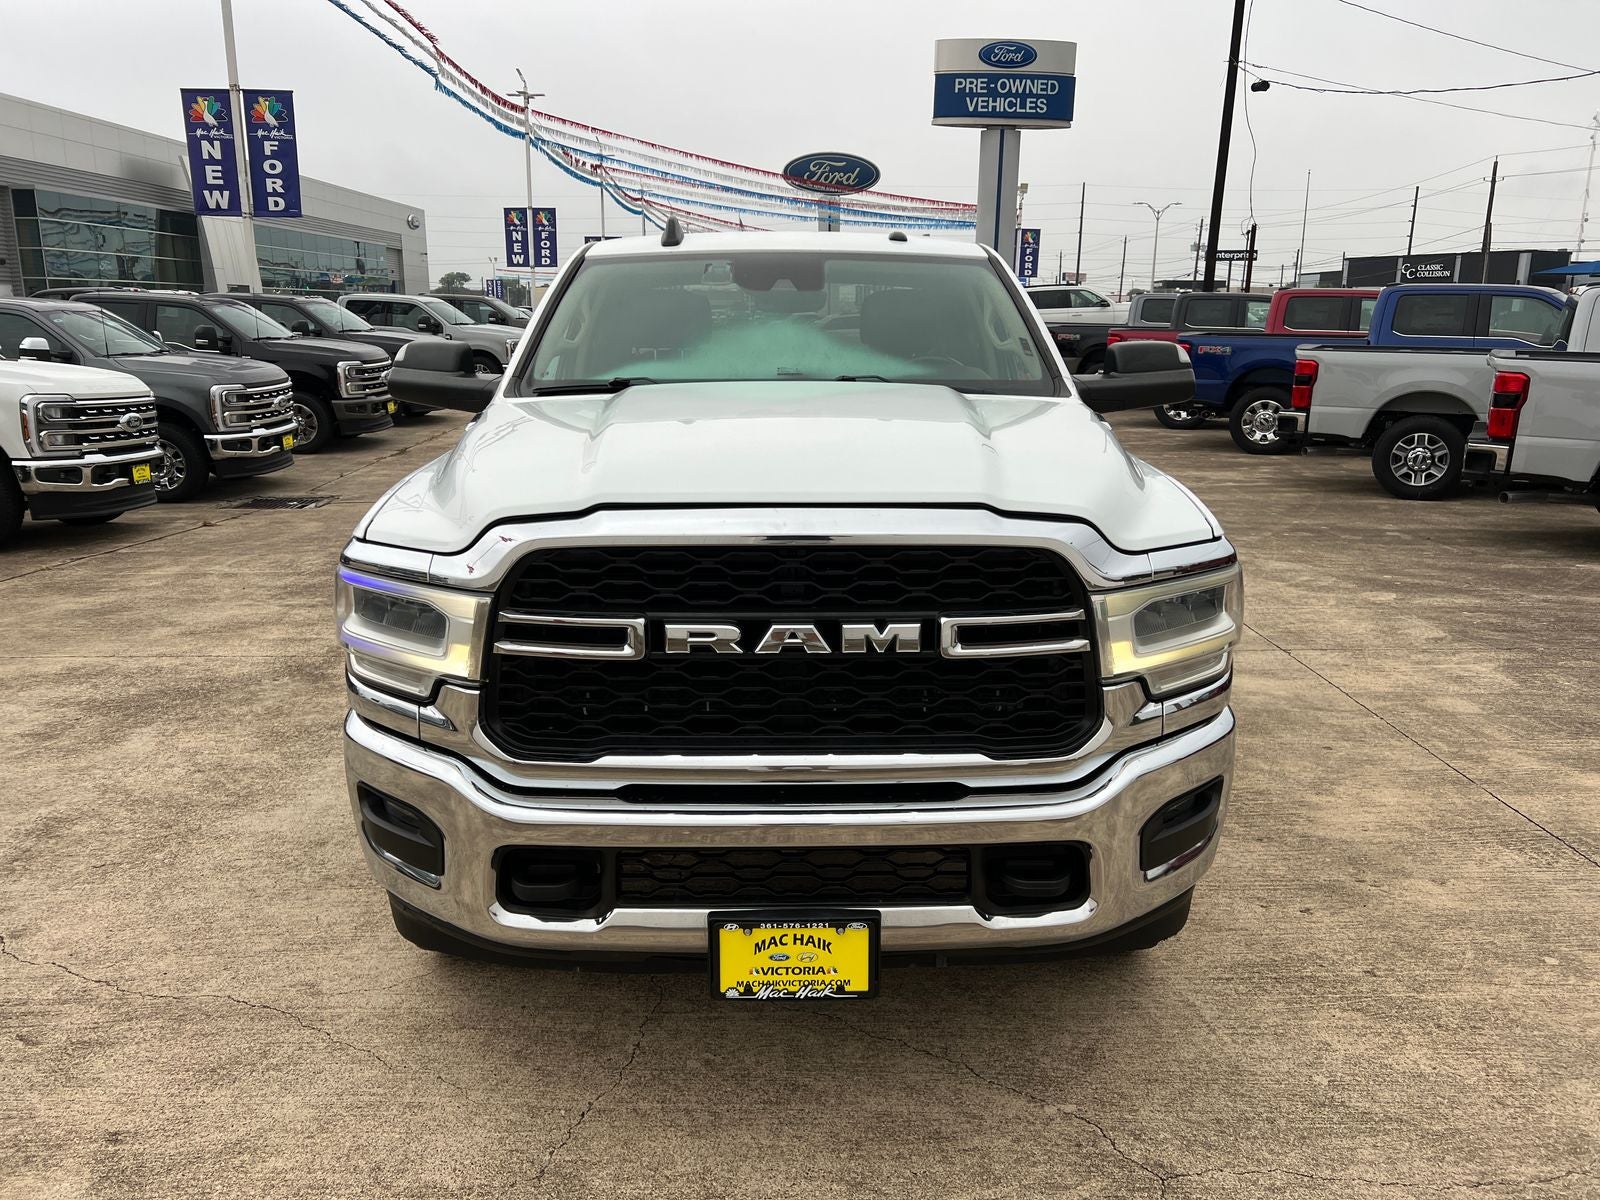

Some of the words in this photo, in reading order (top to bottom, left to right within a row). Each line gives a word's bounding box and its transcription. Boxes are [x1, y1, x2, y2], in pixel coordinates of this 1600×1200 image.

[991, 46, 1024, 62] Ford
[966, 97, 1047, 113] VEHICLES
[201, 140, 230, 209] NEW
[262, 141, 286, 211] FORD
[804, 160, 860, 185] Ford
[512, 231, 524, 264] NEW
[540, 232, 551, 265] FORD
[1024, 248, 1033, 276] FORD
[665, 624, 921, 653] RAM
[754, 934, 788, 955] MAC
[793, 933, 833, 954] HAIK
[771, 952, 788, 961] Ford
[761, 966, 826, 976] VICTORIA
[736, 979, 851, 988] MACHAIKVICTORIA.COM
[755, 985, 794, 999] Mac
[795, 984, 836, 999] Haik
